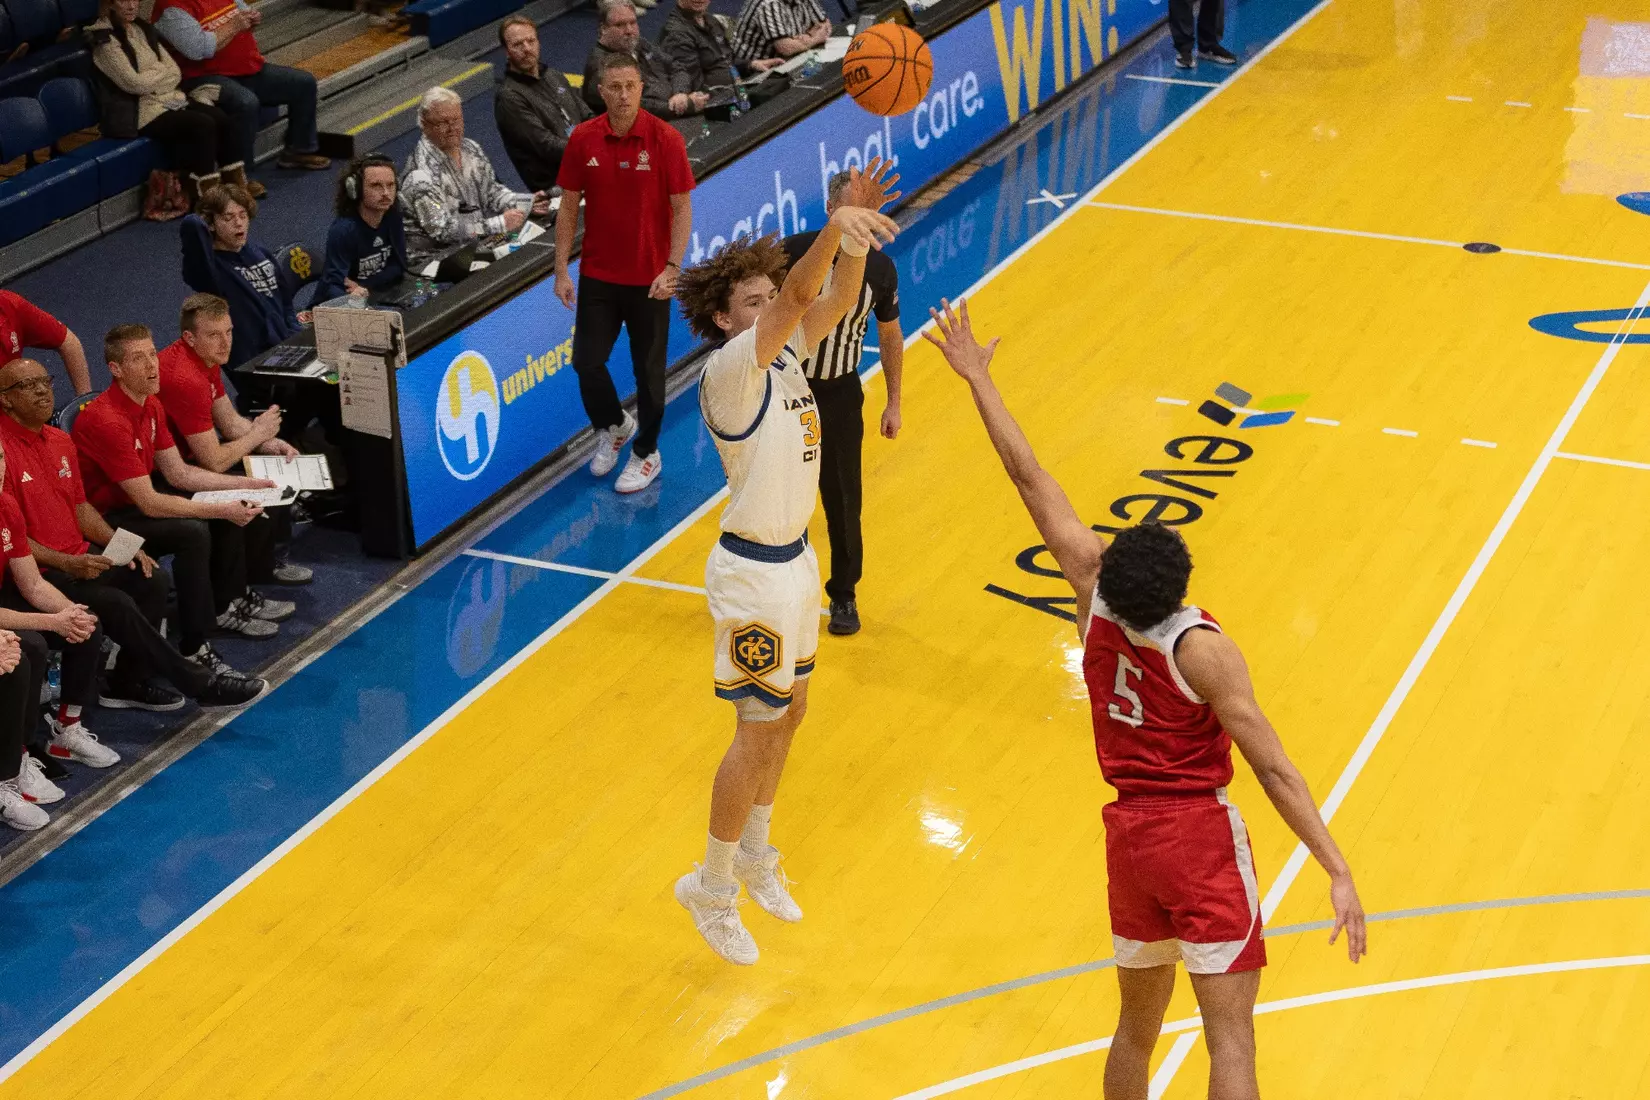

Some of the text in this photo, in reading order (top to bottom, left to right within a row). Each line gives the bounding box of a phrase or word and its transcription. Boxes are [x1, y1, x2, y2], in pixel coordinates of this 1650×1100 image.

[913, 71, 985, 149] care.
[800, 409, 820, 447] 3
[1107, 652, 1145, 729] 5
